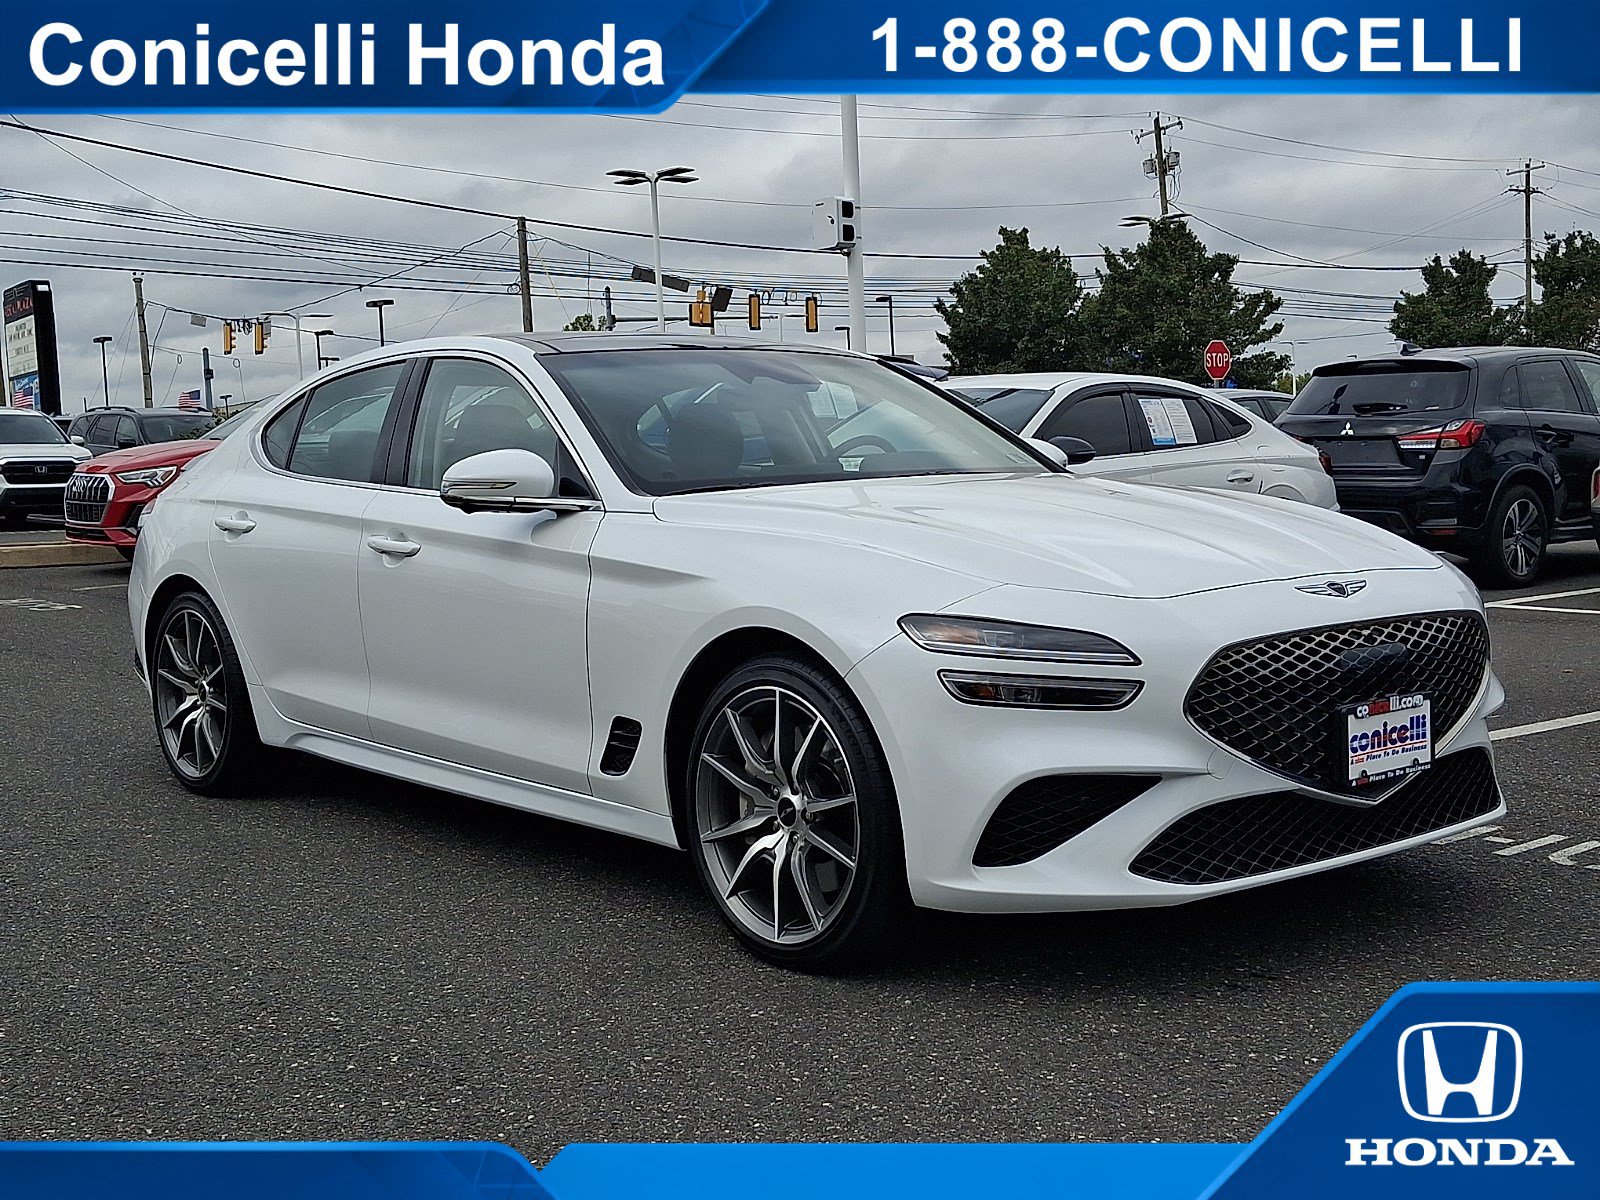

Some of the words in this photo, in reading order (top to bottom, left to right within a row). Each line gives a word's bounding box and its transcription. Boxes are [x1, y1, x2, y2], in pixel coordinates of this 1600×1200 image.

[1206, 353, 1229, 368] STOP
[1356, 694, 1424, 718] conicelli.com
[1350, 713, 1427, 754] conicelli
[1366, 753, 1381, 761] Place
[1401, 744, 1427, 754] Business
[1369, 774, 1386, 782] Place
[1405, 764, 1431, 773] Business
